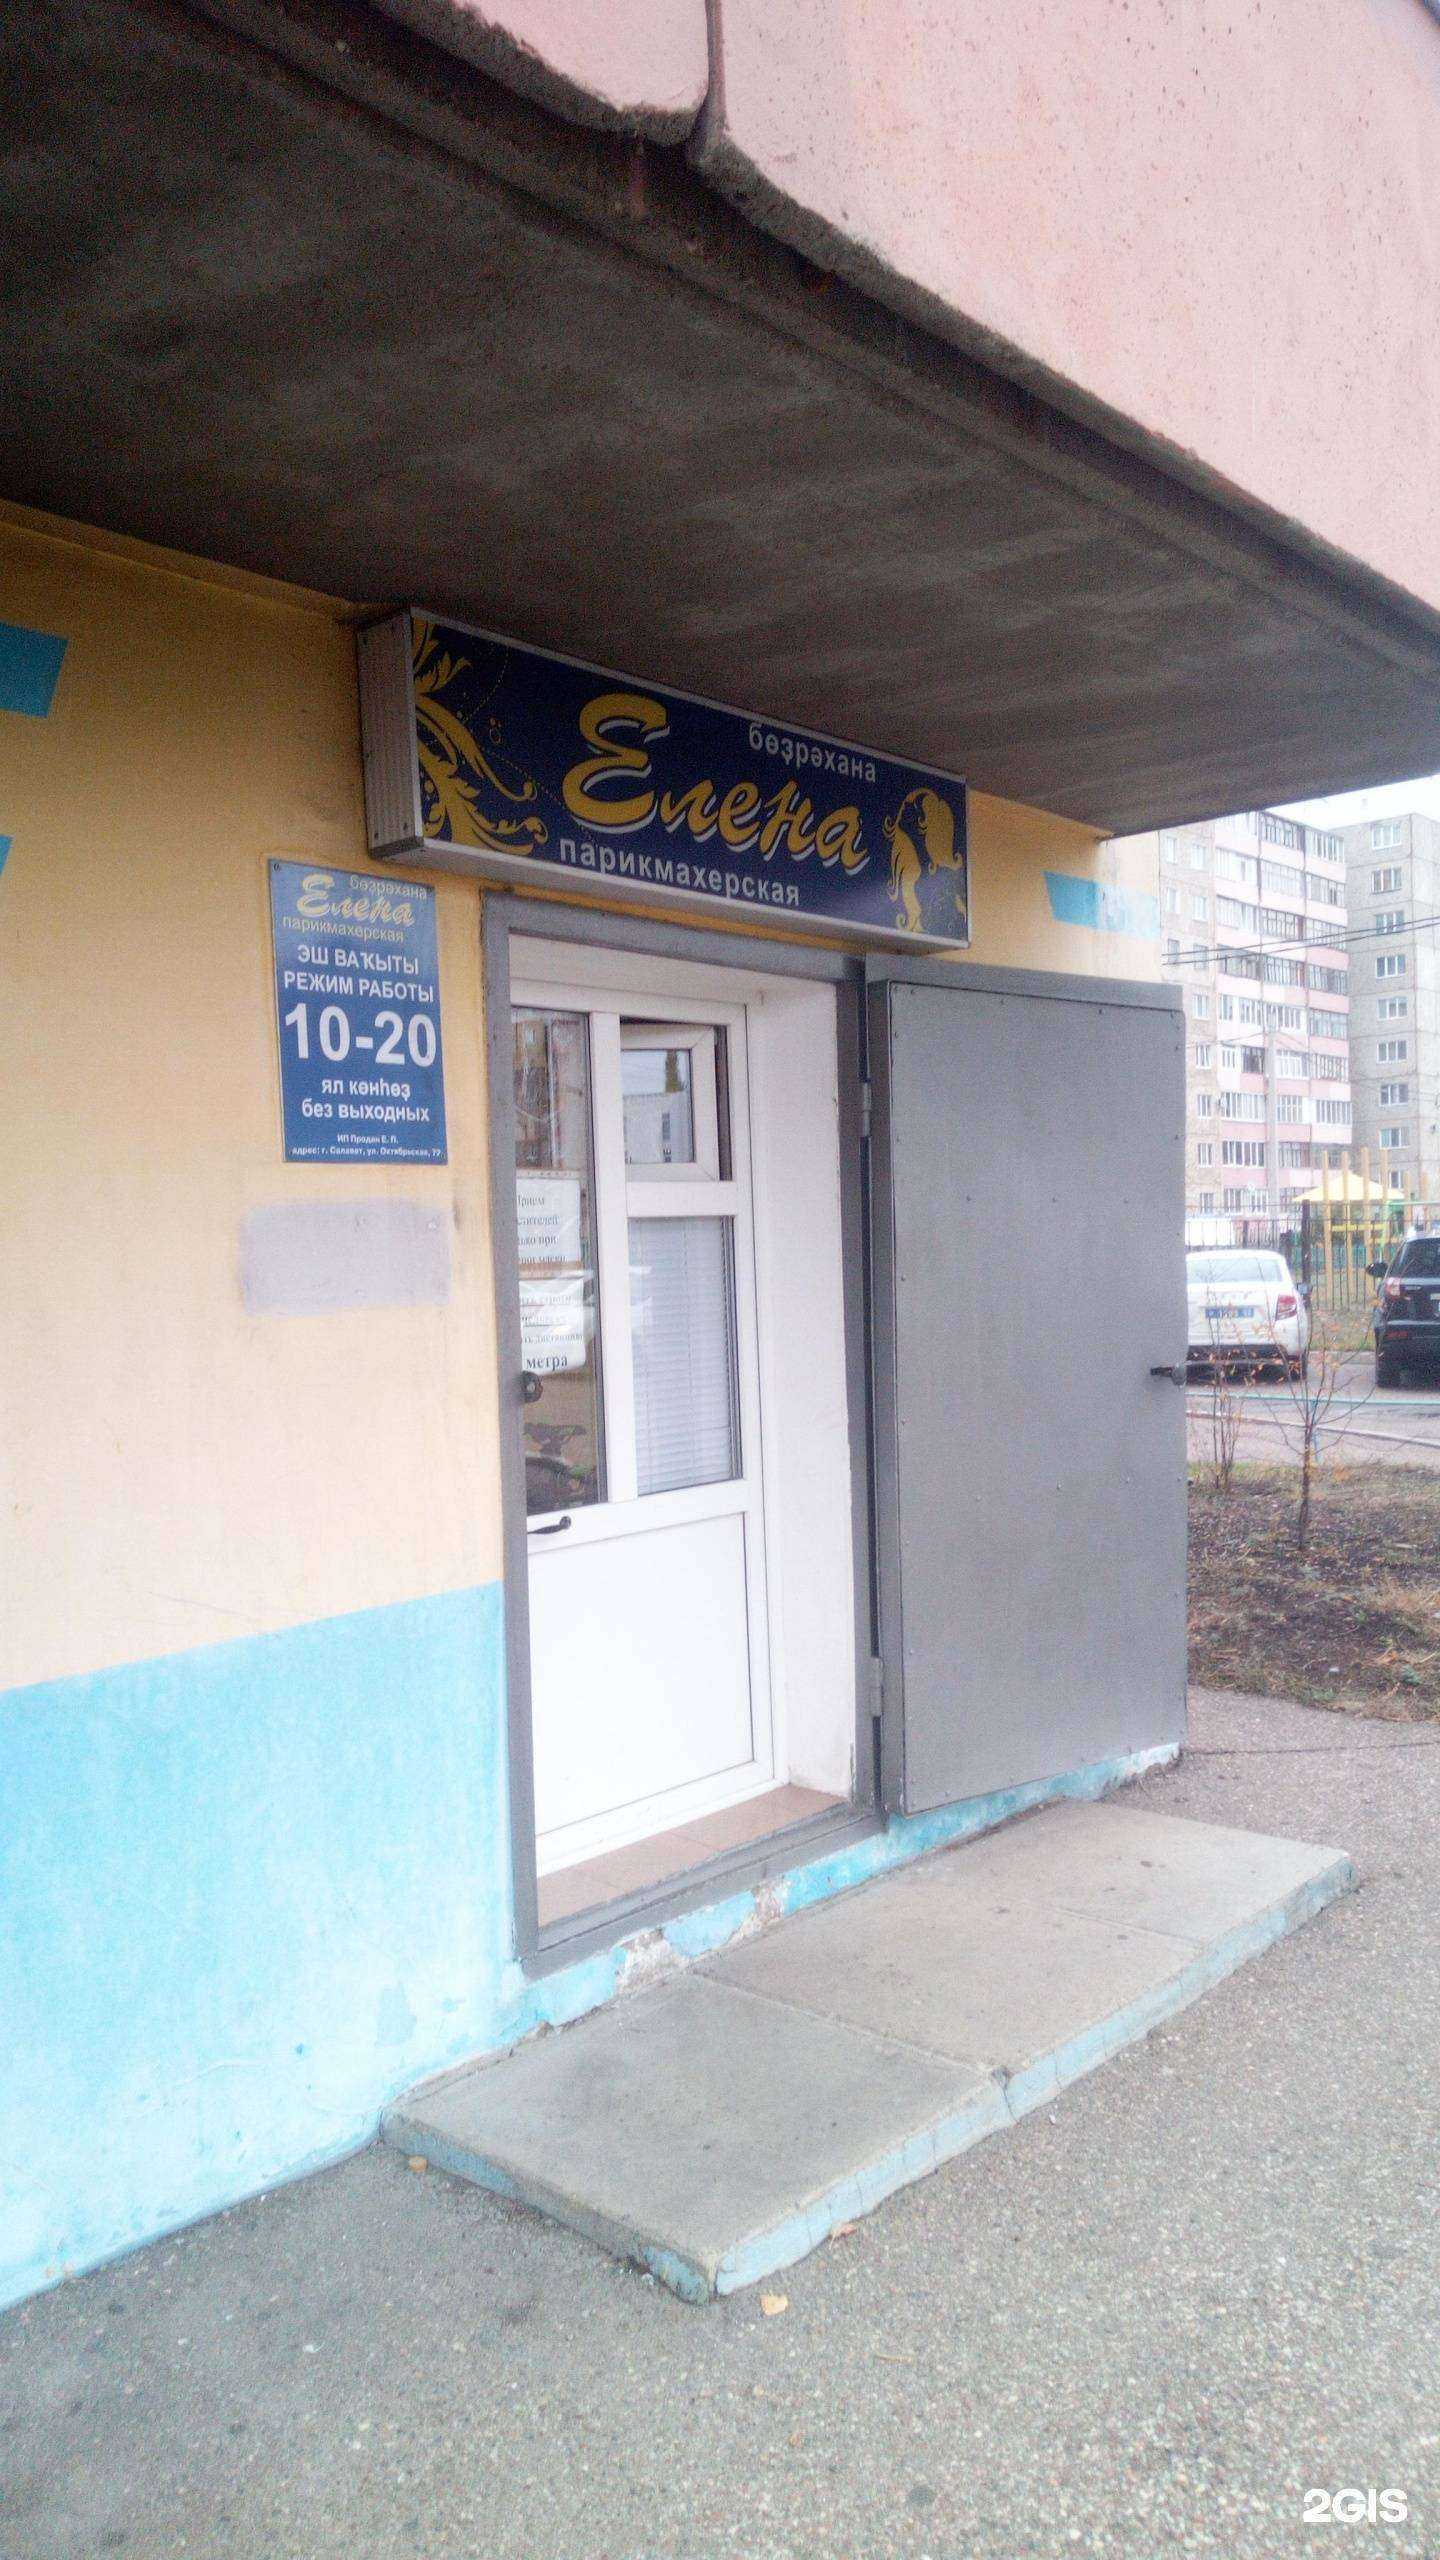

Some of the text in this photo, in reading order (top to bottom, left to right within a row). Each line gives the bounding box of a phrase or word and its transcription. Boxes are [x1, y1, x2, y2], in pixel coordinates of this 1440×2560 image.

[562, 693, 871, 875] Елена
[559, 838, 800, 906] парикмахерская
[297, 873, 415, 926] Елена
[282, 915, 404, 942] парикмахерская
[298, 945, 329, 965] ЭШ
[284, 971, 434, 1002] РЕЖИМ РАБОТЫ
[285, 1002, 437, 1067] 10-20
[322, 1078, 344, 1095] ял
[302, 1098, 430, 1122] без выходных
[336, 1133, 350, 1143] ИП
[292, 1147, 320, 1156] адрес:
[321, 1147, 328, 1155] г.
[329, 1146, 365, 1156] Салават,
[366, 1147, 379, 1156] ул.
[526, 1354, 569, 1372] метра
